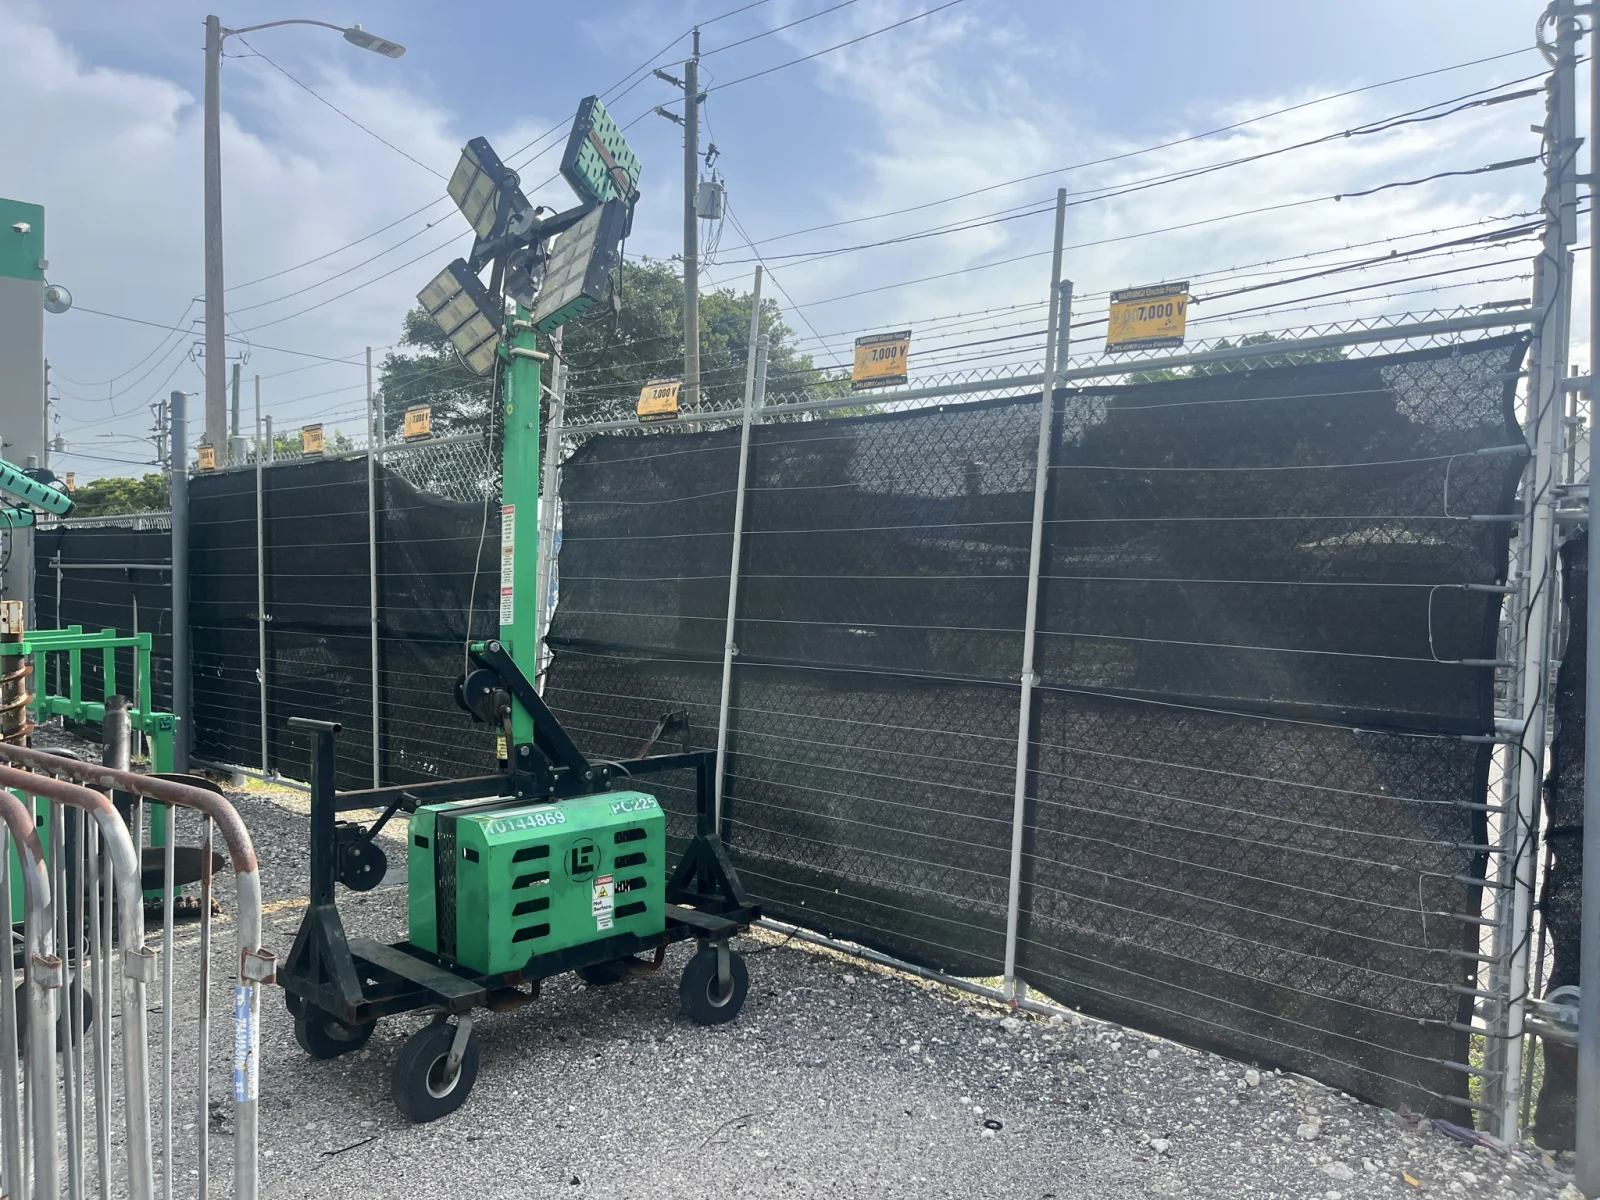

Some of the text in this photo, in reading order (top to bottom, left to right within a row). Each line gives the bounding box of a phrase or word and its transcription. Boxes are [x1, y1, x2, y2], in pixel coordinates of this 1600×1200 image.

[1146, 287, 1165, 296] Electric
[1166, 285, 1181, 294] Fence
[1138, 303, 1173, 322] 7,000
[1177, 301, 1185, 316] V
[872, 346, 897, 362] 7,000
[900, 345, 906, 357] V
[653, 387, 677, 400] 7,000 V
[611, 797, 658, 814] PC225
[593, 904, 612, 912] Surface
